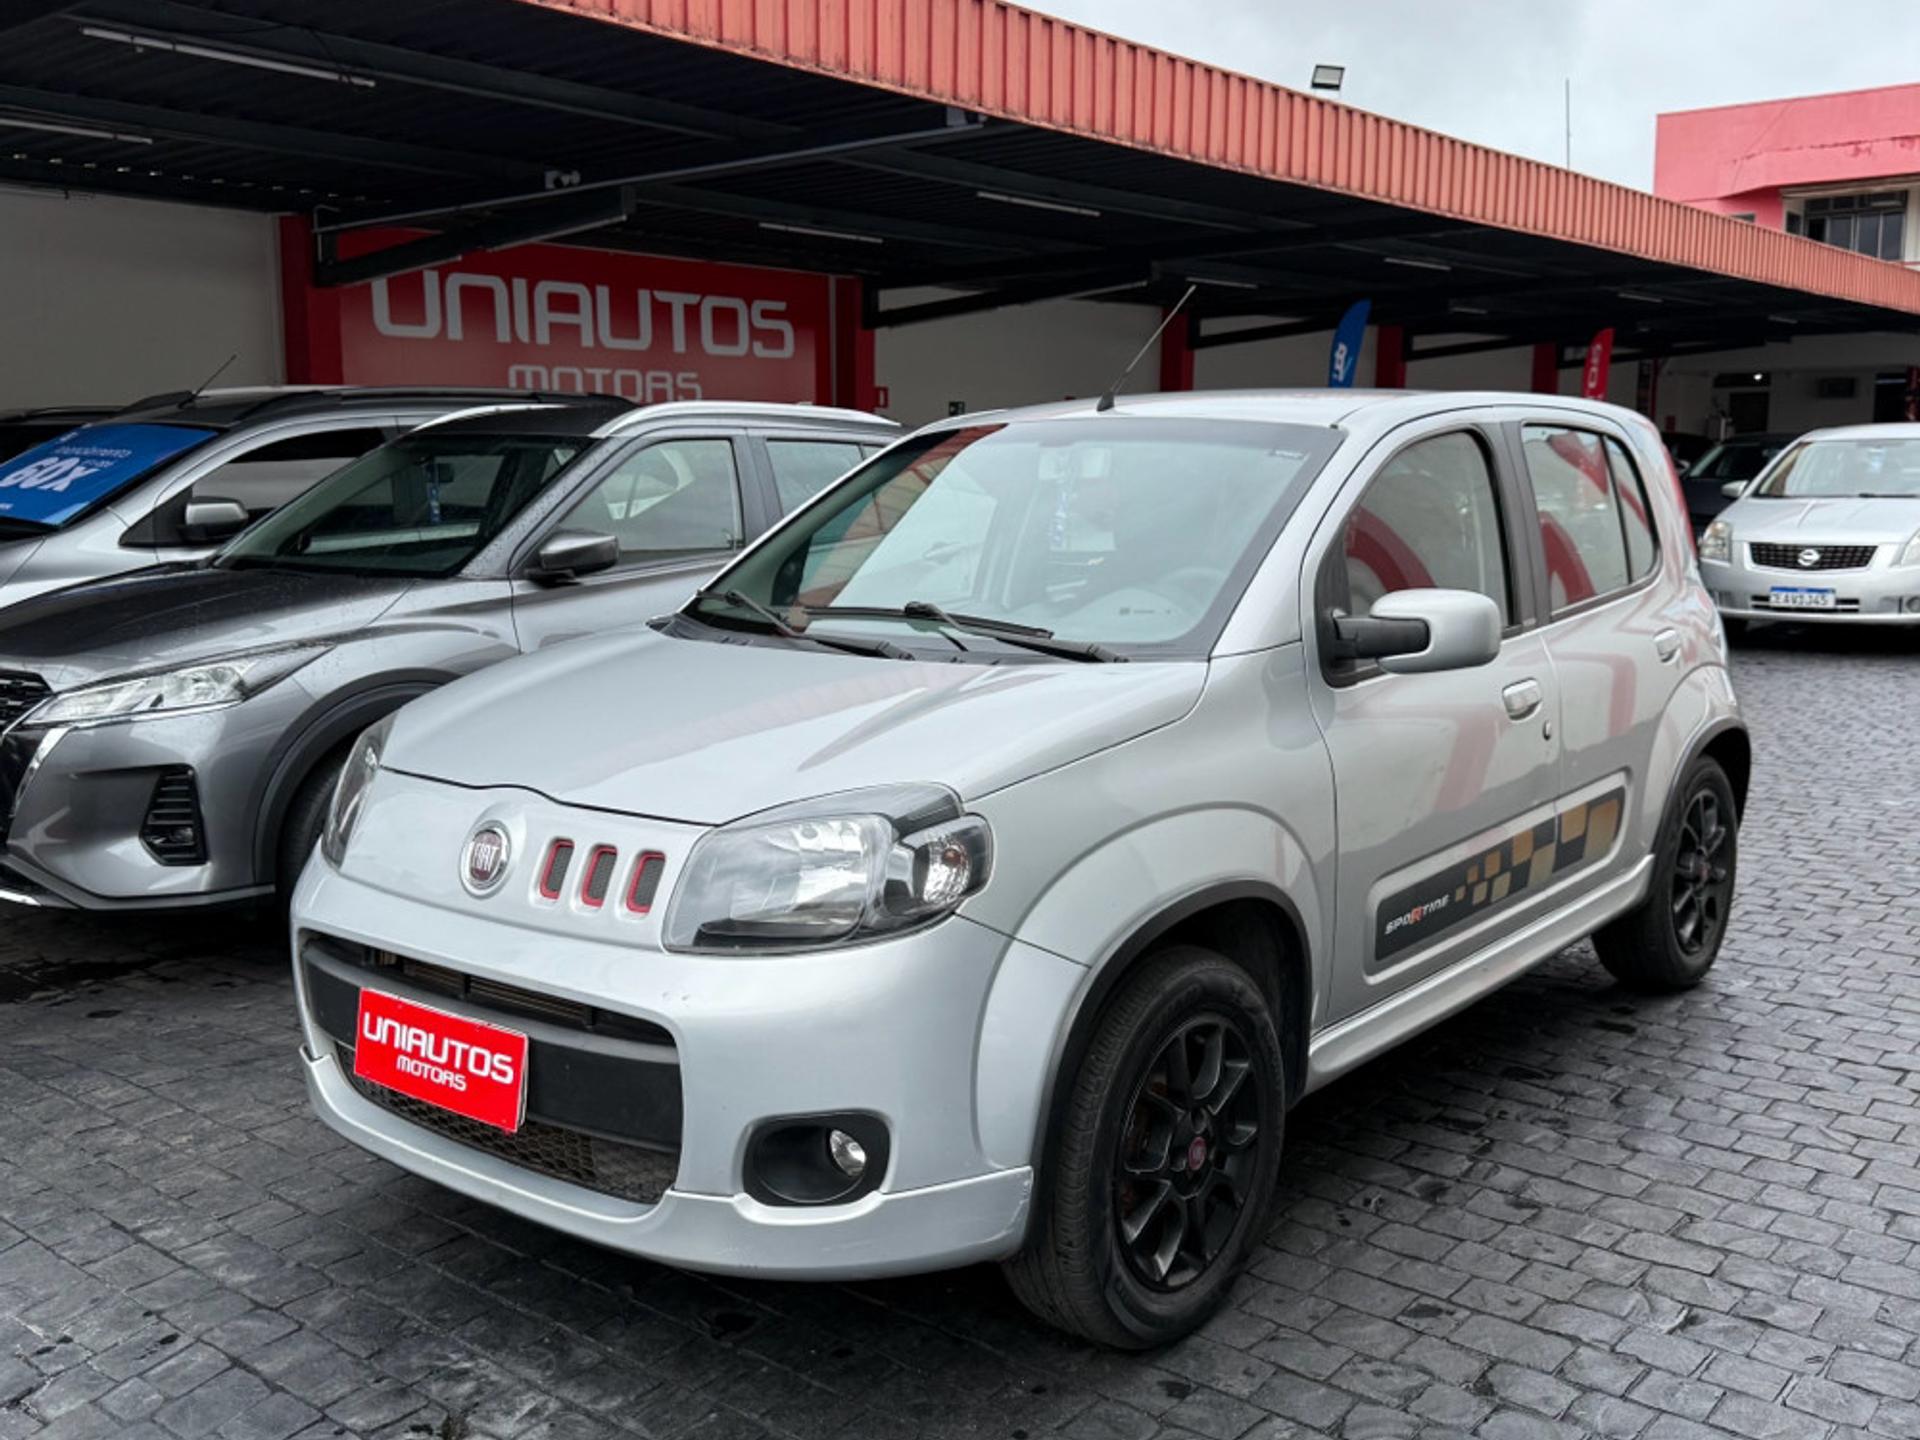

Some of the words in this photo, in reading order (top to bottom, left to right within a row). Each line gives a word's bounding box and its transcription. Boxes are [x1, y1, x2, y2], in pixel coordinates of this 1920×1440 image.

[371, 269, 794, 359] UNIAUTOS
[508, 364, 703, 402] MOTORS
[473, 843, 500, 871] FIAT
[363, 1011, 514, 1085] UNIAUTOS
[396, 1055, 467, 1092] MOTORS
